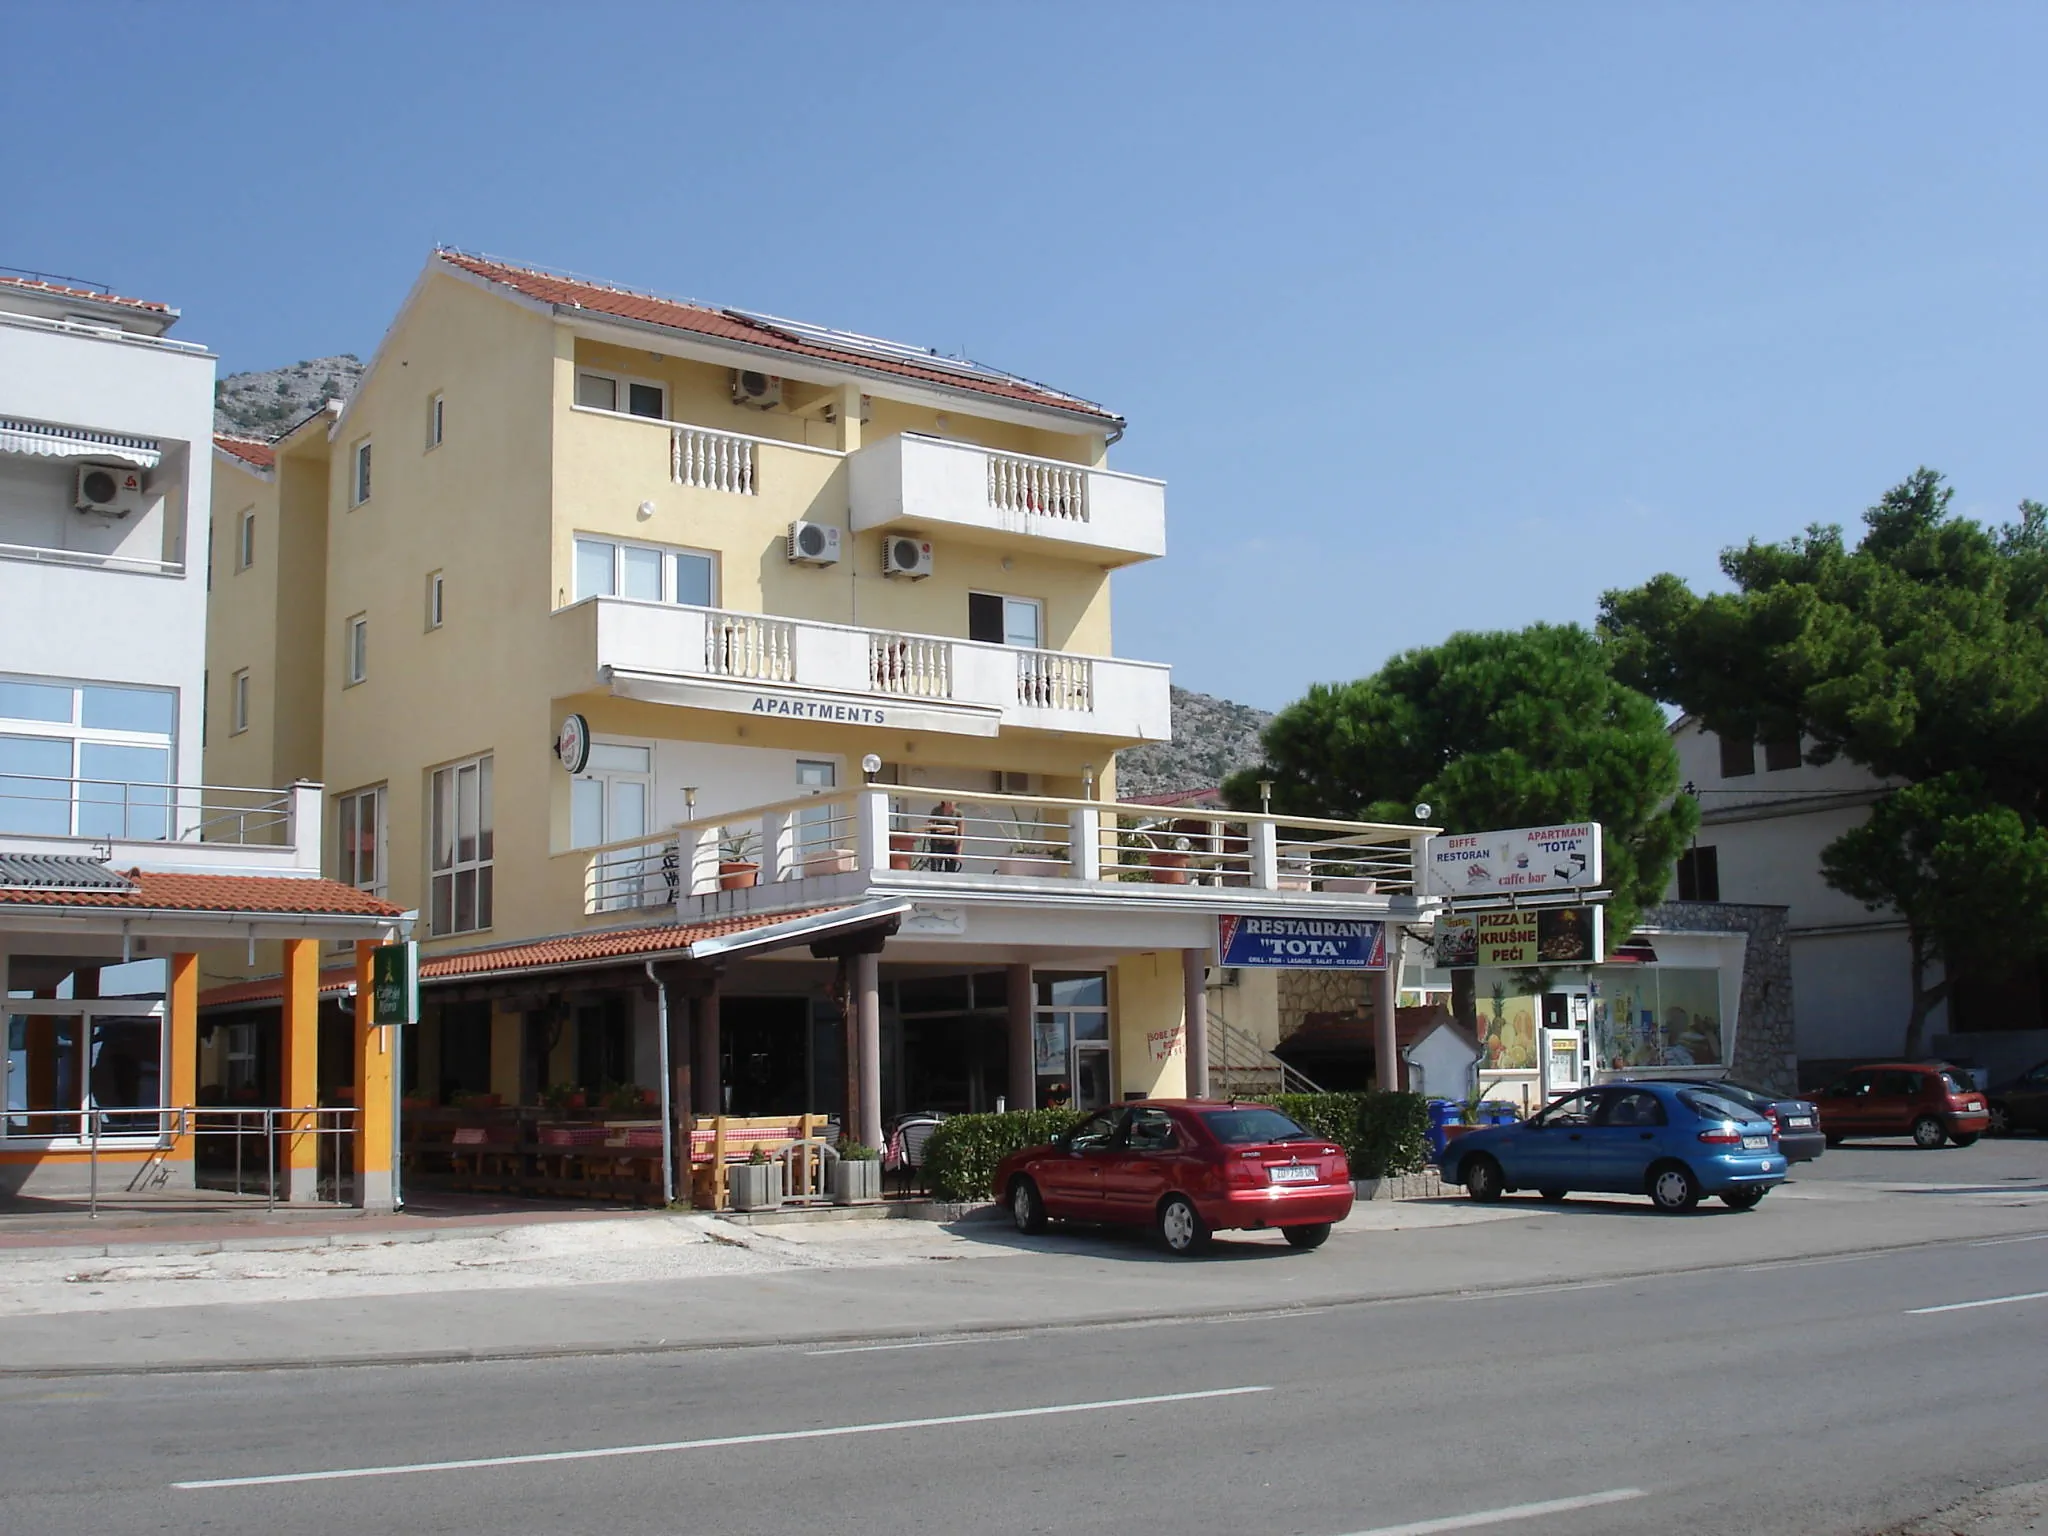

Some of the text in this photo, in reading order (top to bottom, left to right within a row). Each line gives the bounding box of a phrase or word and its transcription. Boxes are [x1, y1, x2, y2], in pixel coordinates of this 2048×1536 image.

[752, 697, 885, 724] APARTMENTS
[1527, 827, 1589, 841] APARTMANI
[1449, 837, 1477, 848] BIFFE
[1537, 839, 1582, 853] "TOTA"
[1436, 849, 1490, 862] RESTORAN
[1498, 872, 1547, 885] caffe bar
[1480, 913, 1519, 927] PIZZA
[1523, 912, 1536, 924] IZ
[1246, 919, 1374, 937] RESTAURANT
[1480, 928, 1536, 944] KRUŠNE
[1260, 938, 1347, 956] "TOTA"
